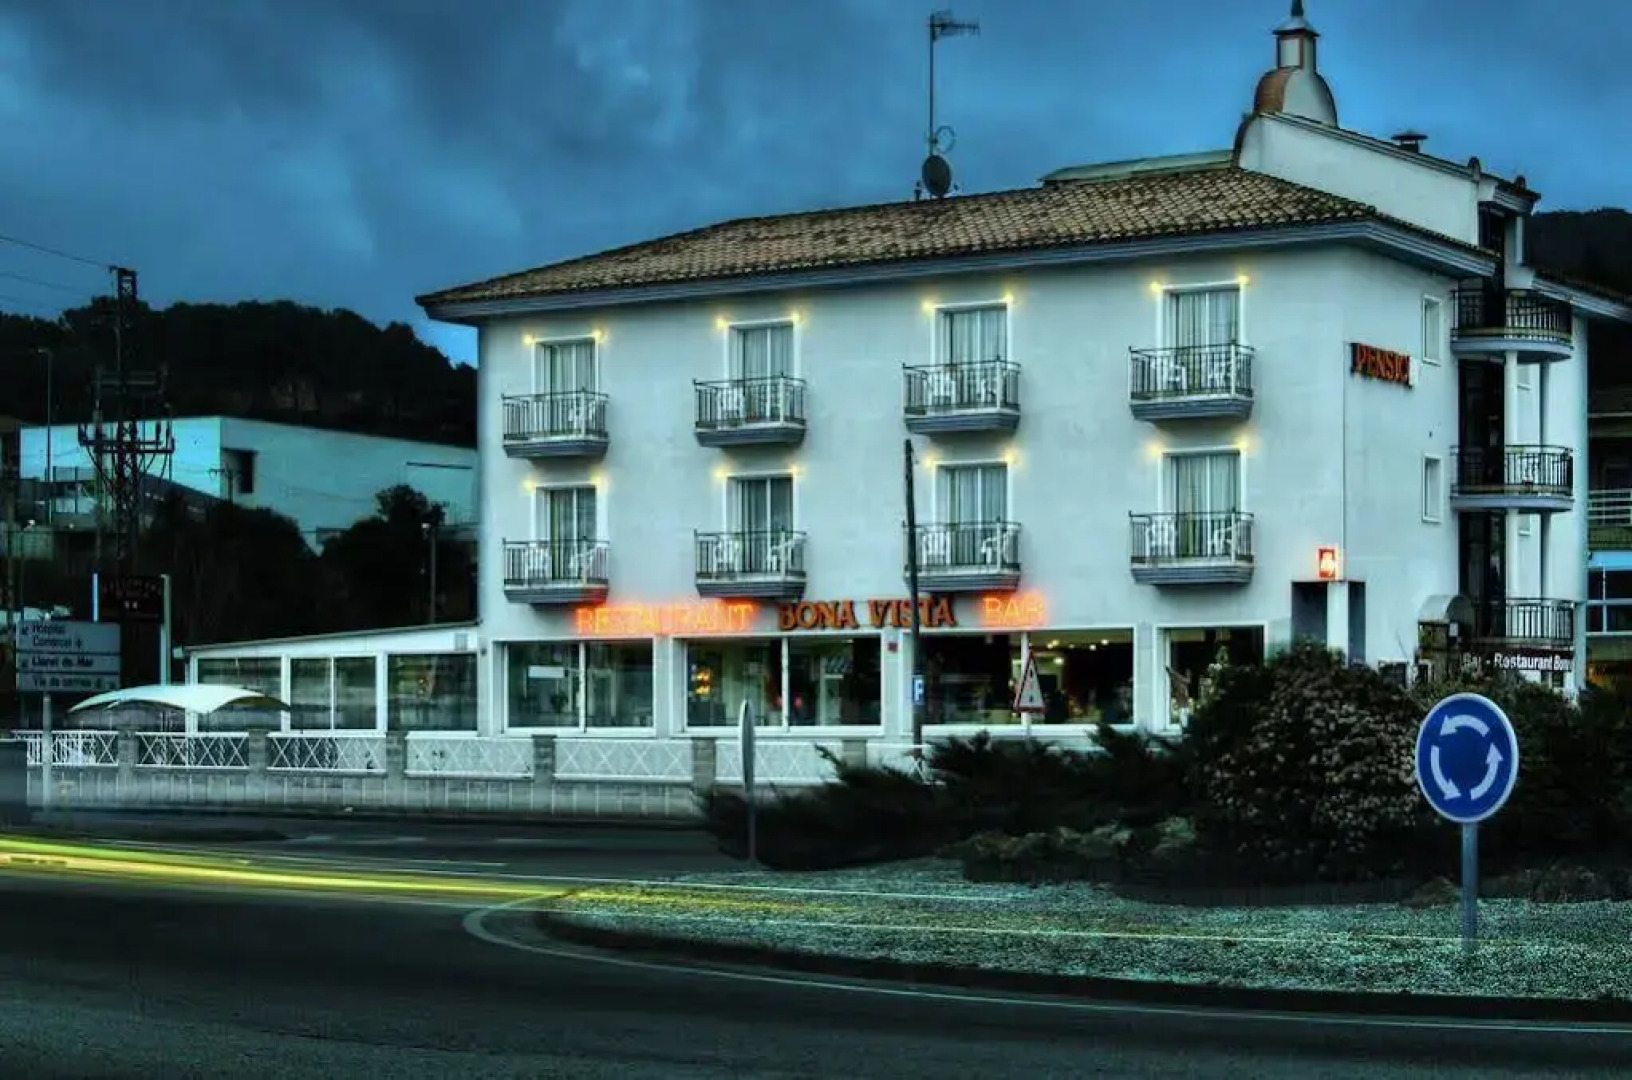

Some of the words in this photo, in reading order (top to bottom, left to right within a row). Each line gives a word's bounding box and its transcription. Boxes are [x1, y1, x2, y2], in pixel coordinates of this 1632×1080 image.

[576, 602, 754, 635] RESTAURANT
[778, 600, 859, 630] BONA
[868, 595, 957, 628] VISTA
[981, 594, 1045, 627] BAR
[1494, 652, 1552, 670] Restaurant
